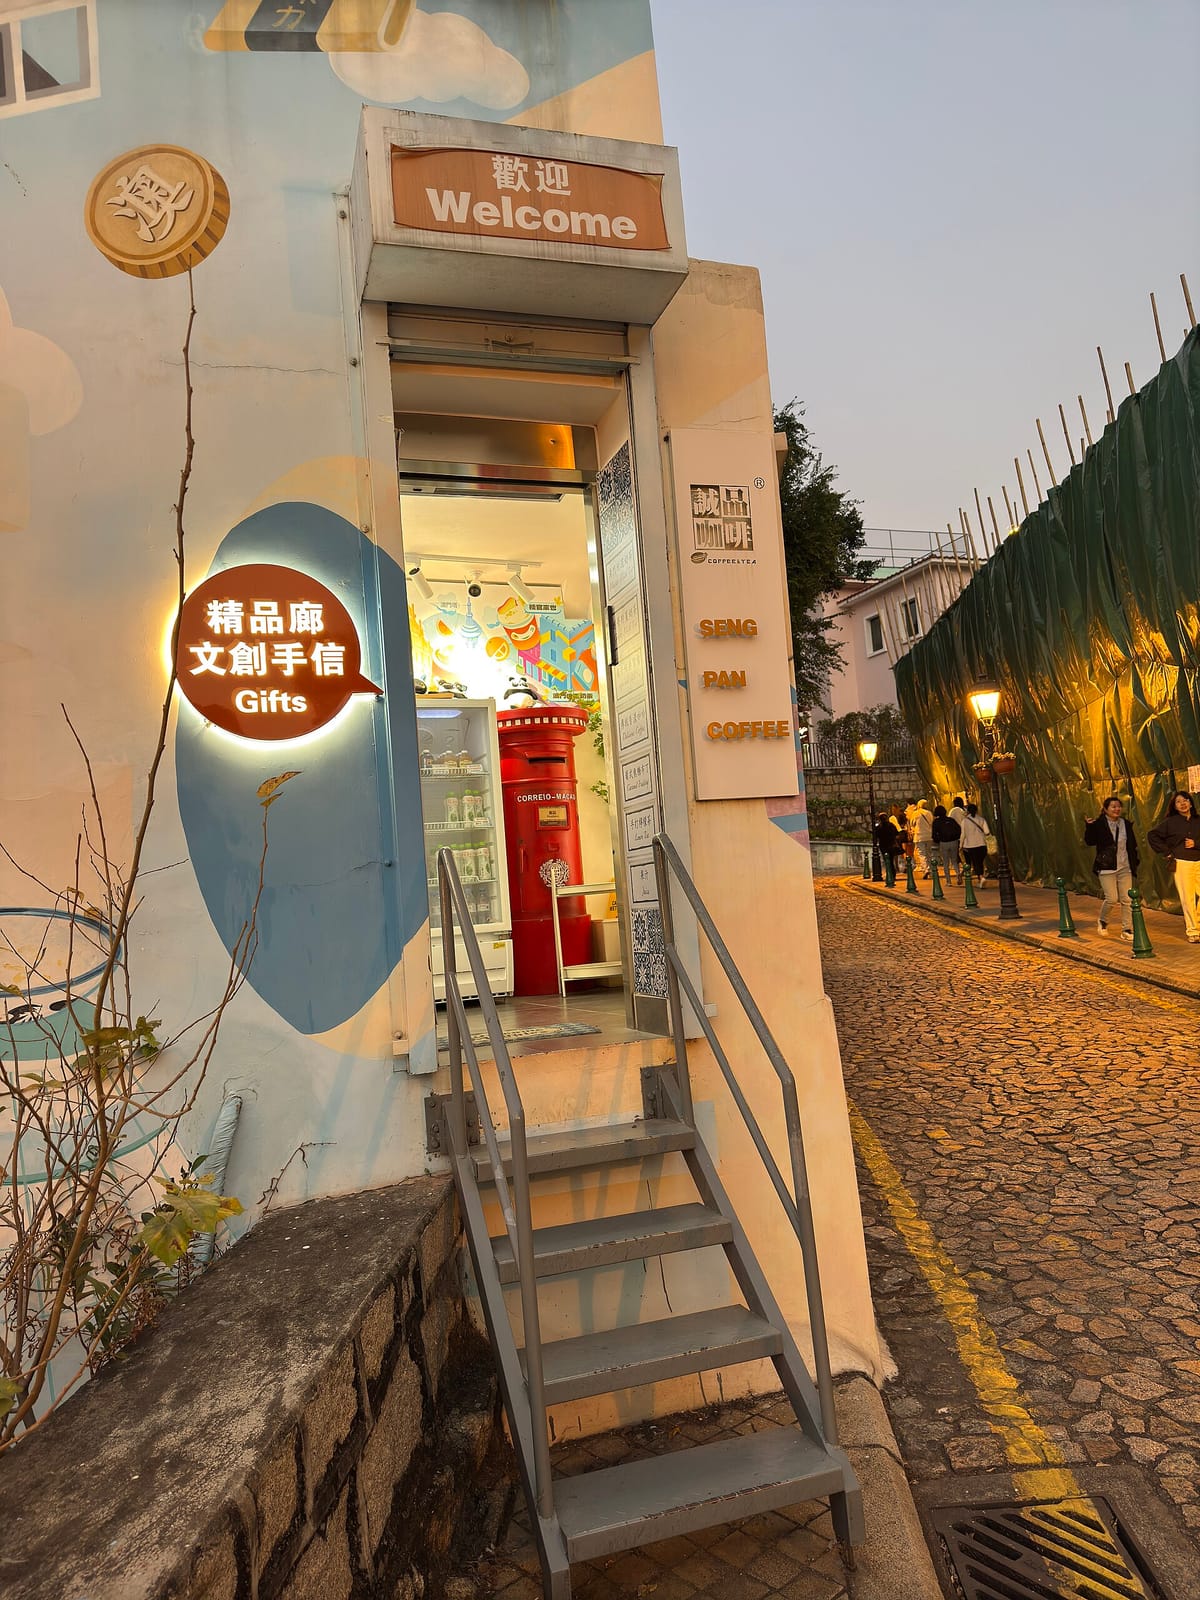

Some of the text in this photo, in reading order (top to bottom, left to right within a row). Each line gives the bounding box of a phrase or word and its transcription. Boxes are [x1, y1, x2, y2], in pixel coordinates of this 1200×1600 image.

[492, 155, 572, 196] 歡迎
[425, 187, 638, 240] Welcome
[693, 519, 753, 550] 咖啡
[206, 599, 324, 635] 精品廊
[699, 619, 758, 637] SENG
[189, 641, 346, 677] 文創手信
[703, 670, 747, 688] PAN
[234, 690, 308, 713] Gifts
[706, 720, 790, 739] COFFEE
